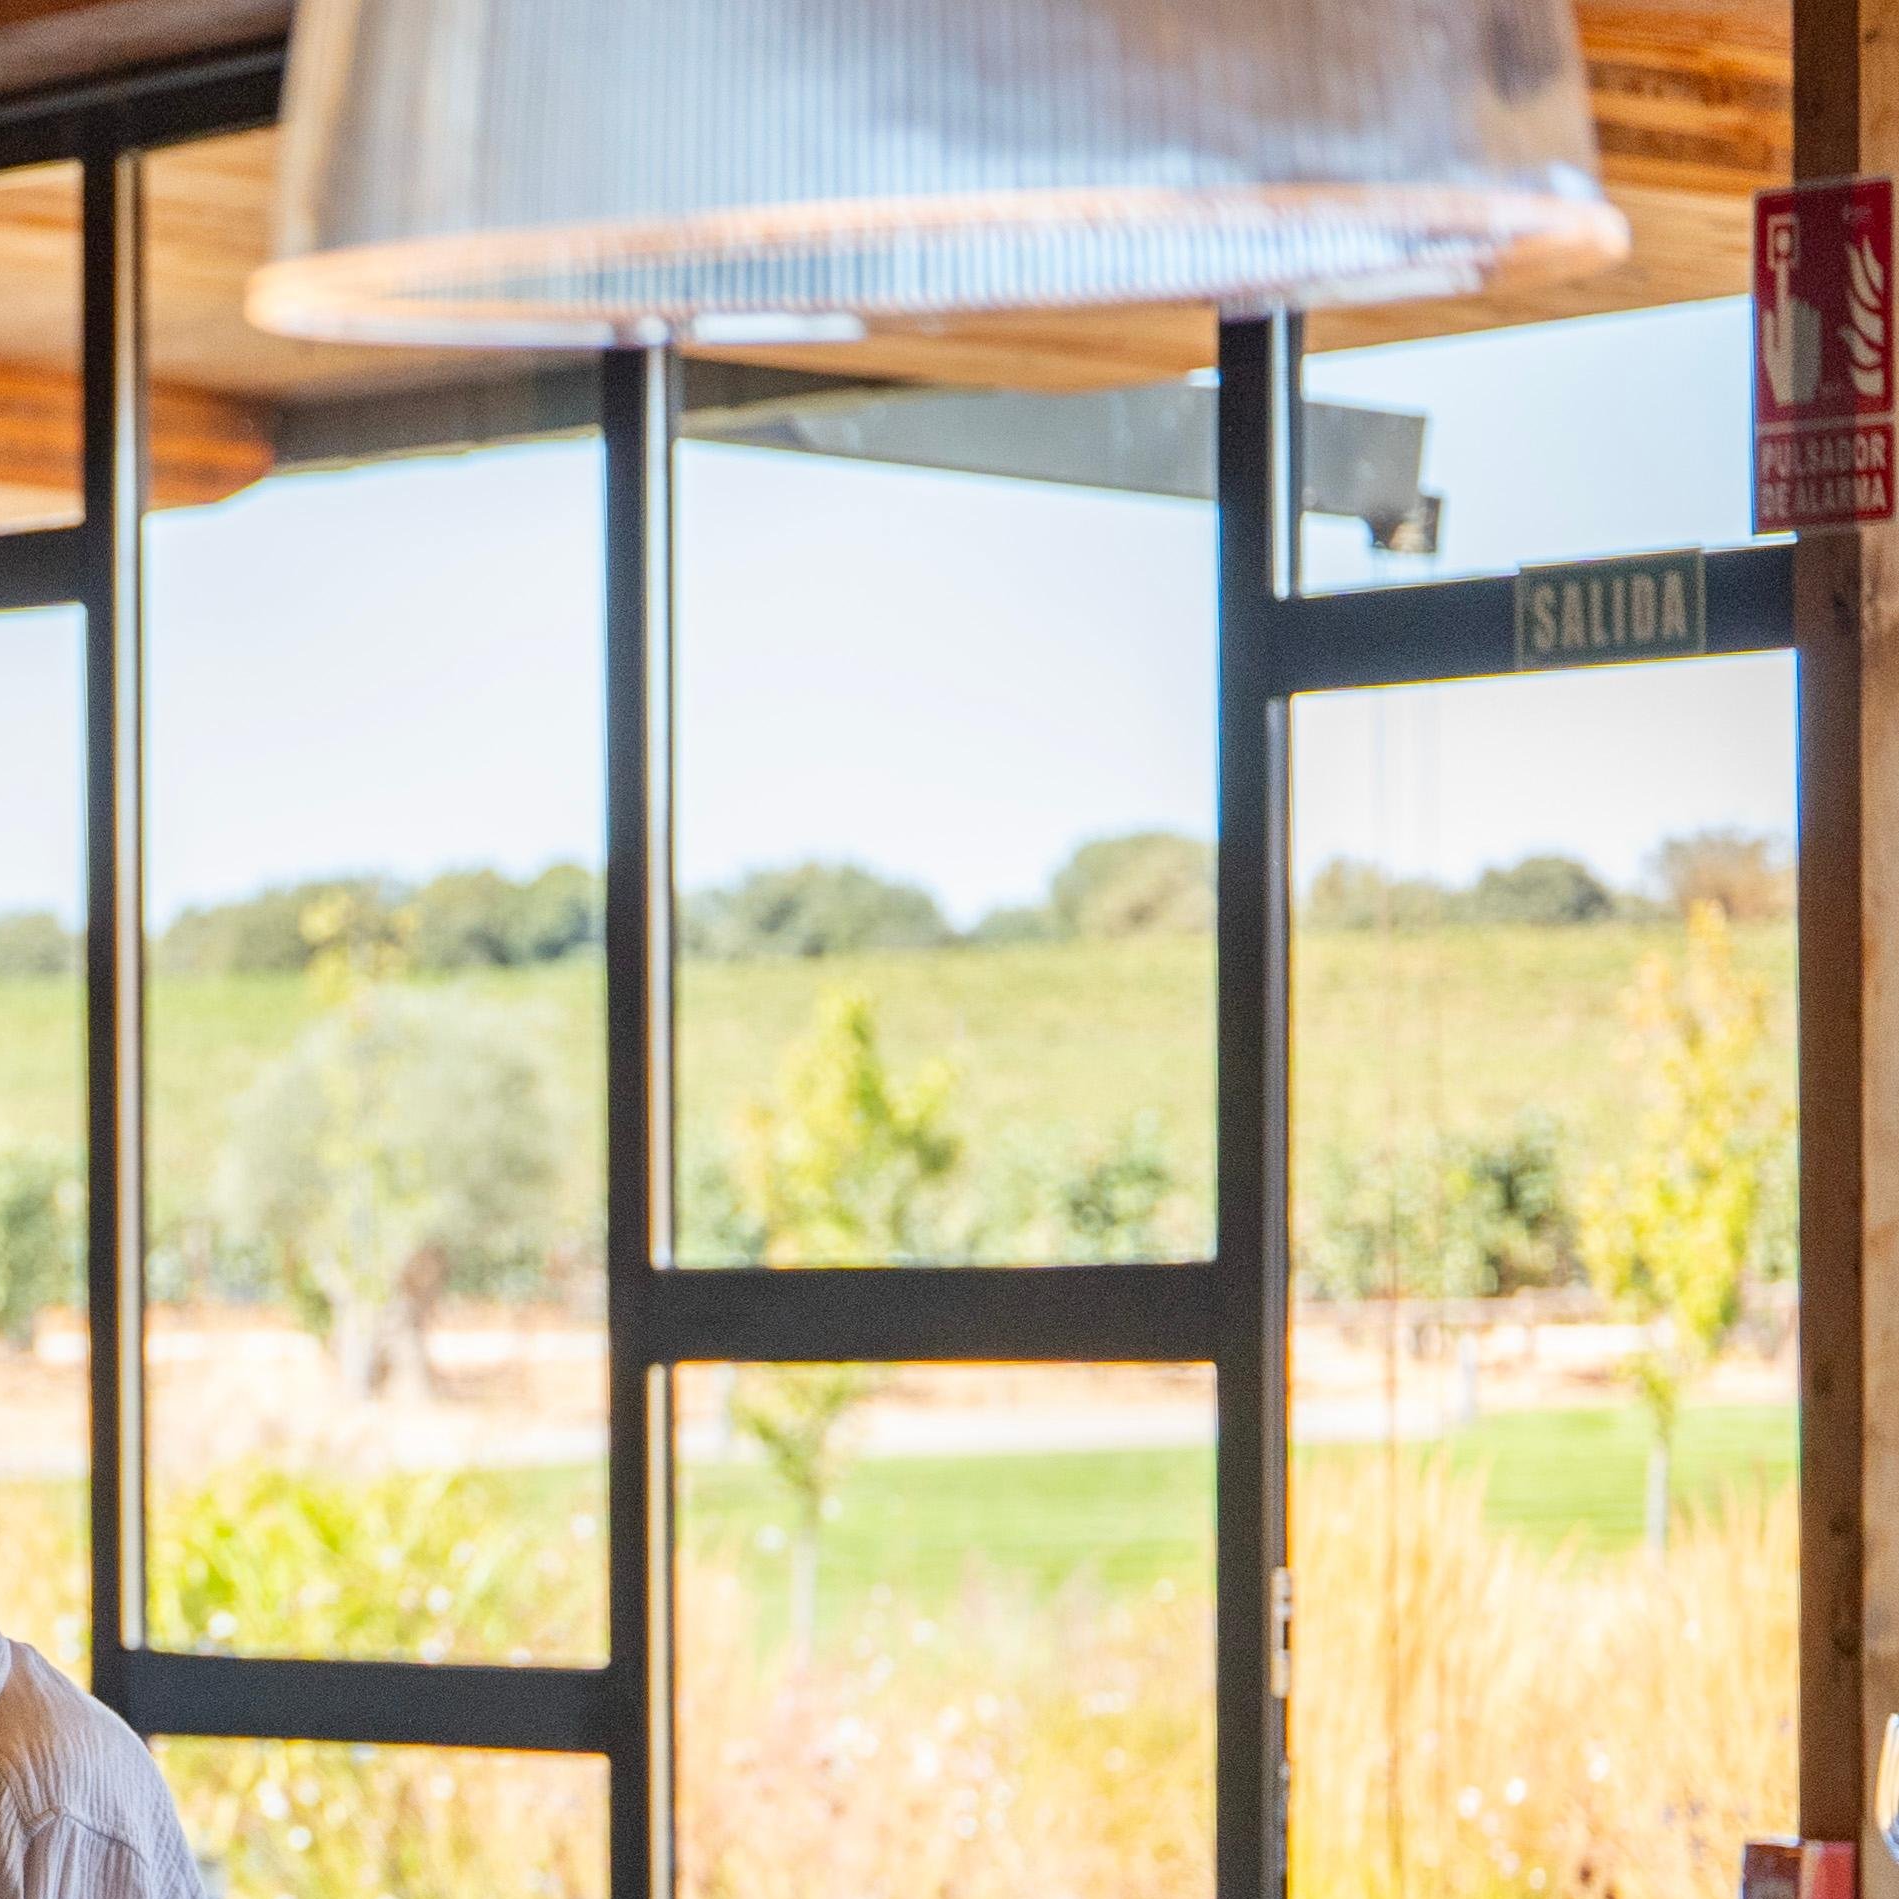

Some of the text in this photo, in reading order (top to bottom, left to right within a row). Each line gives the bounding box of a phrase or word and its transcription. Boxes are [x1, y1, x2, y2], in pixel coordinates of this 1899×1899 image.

[1761, 432, 1886, 478] PULSADOR
[1761, 473, 1887, 518] DE ALARMA
[1533, 569, 1686, 649] SALIDA
